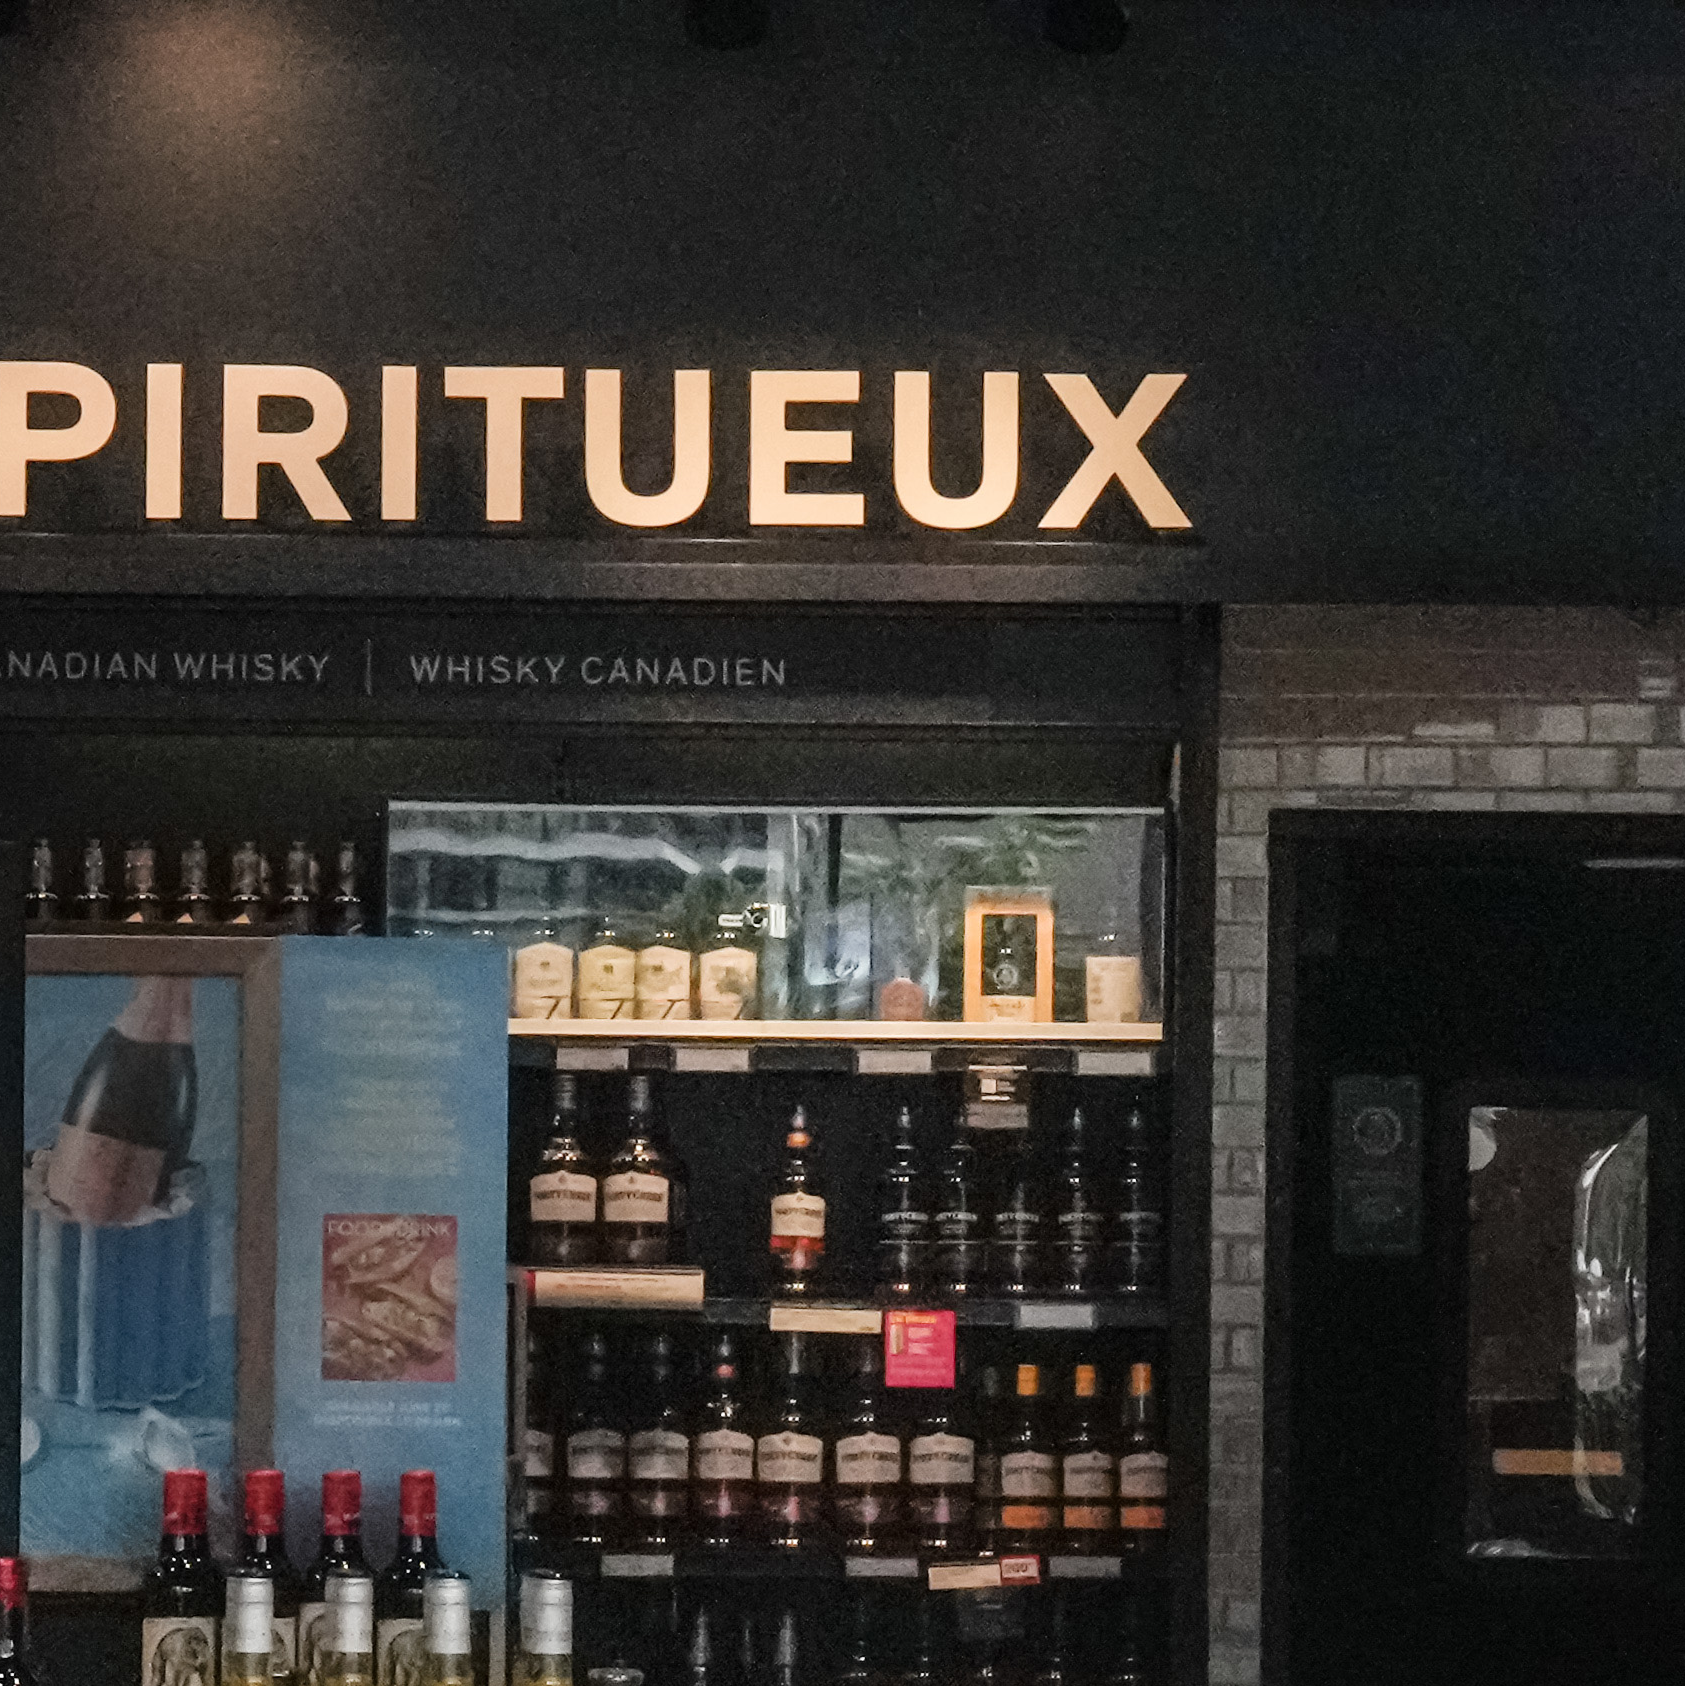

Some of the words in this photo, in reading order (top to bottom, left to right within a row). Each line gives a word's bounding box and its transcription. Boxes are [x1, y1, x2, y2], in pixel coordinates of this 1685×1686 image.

[173, 651, 332, 685] WHISKY
[411, 653, 567, 686] WHISKY
[581, 655, 788, 686] CANADIEN
